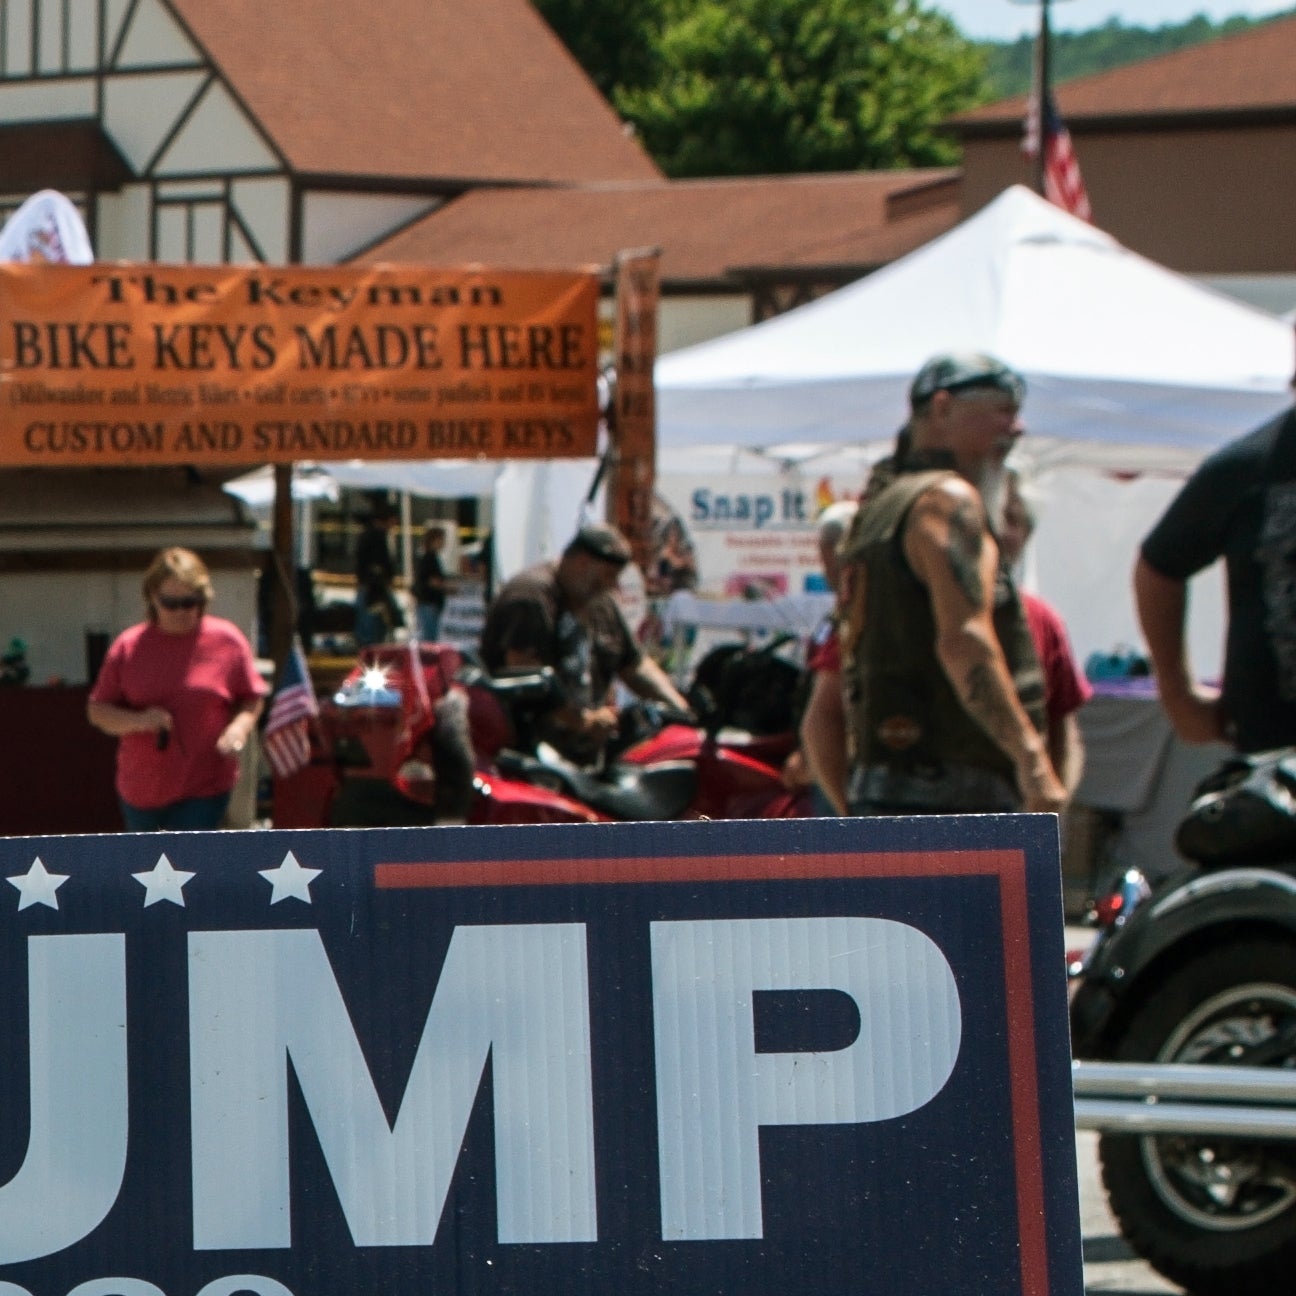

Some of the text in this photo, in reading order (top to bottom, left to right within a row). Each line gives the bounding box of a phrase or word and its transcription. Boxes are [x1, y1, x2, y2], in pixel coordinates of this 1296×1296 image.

[92, 273, 502, 311] The Keyman
[14, 323, 585, 372] BIKE KEYS MADE HERE
[24, 420, 574, 453] CUSTOM AND STANDARD BIKE KEYS
[691, 486, 775, 528] Snap
